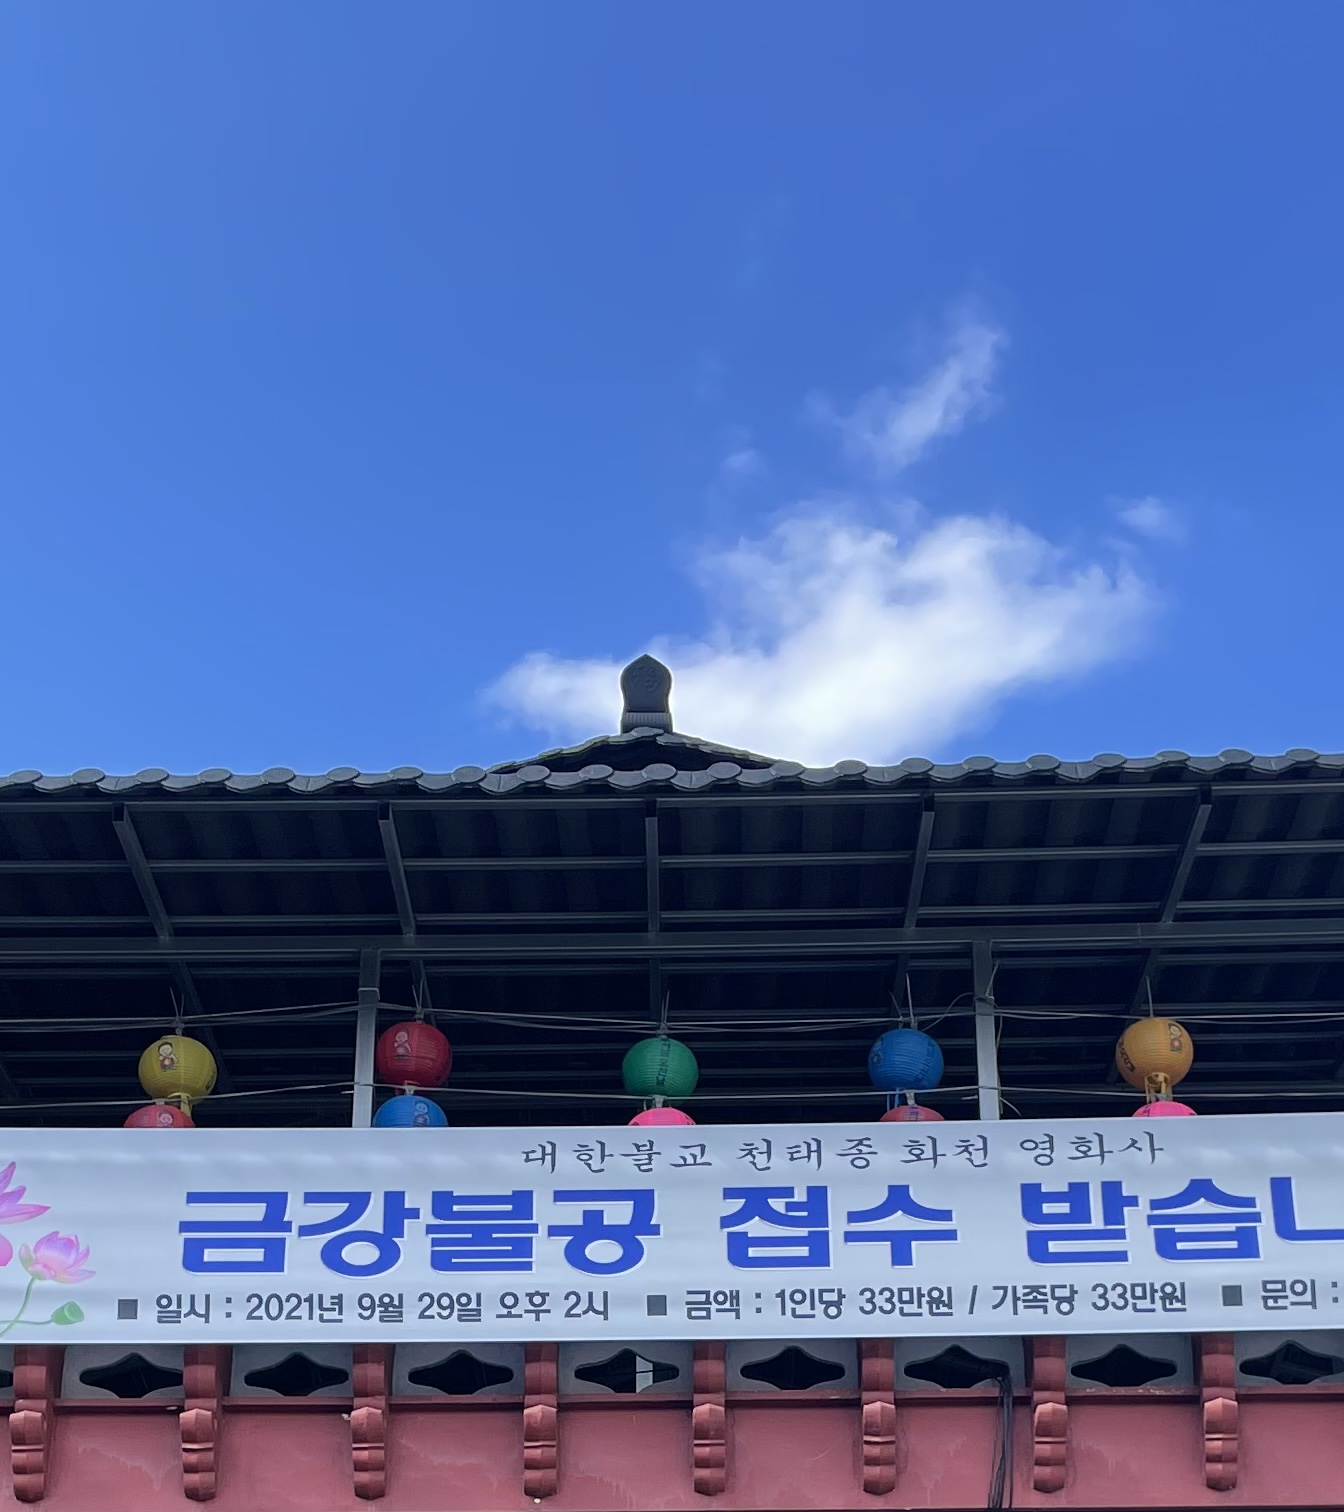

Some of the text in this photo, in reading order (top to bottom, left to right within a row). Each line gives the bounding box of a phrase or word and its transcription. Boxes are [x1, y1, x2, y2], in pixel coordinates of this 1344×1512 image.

[523, 1131, 1164, 1175] 대한불교 천태종 화천 영화사
[179, 1188, 662, 1279] 금강불공
[719, 1183, 961, 1271] 접수
[155, 1293, 210, 1324] 일시
[245, 1291, 344, 1323] 2021년
[357, 1292, 404, 1323] 9월
[416, 1291, 483, 1322] 29일
[496, 1290, 551, 1321] 오후
[563, 1289, 610, 1321] 2시
[684, 1288, 741, 1320] 금액
[775, 1287, 845, 1319] 1인당
[858, 1285, 954, 1317] 33만원
[990, 1283, 1078, 1316] 가족당
[1090, 1281, 1187, 1314] 33만원
[1260, 1279, 1317, 1311] 문의
